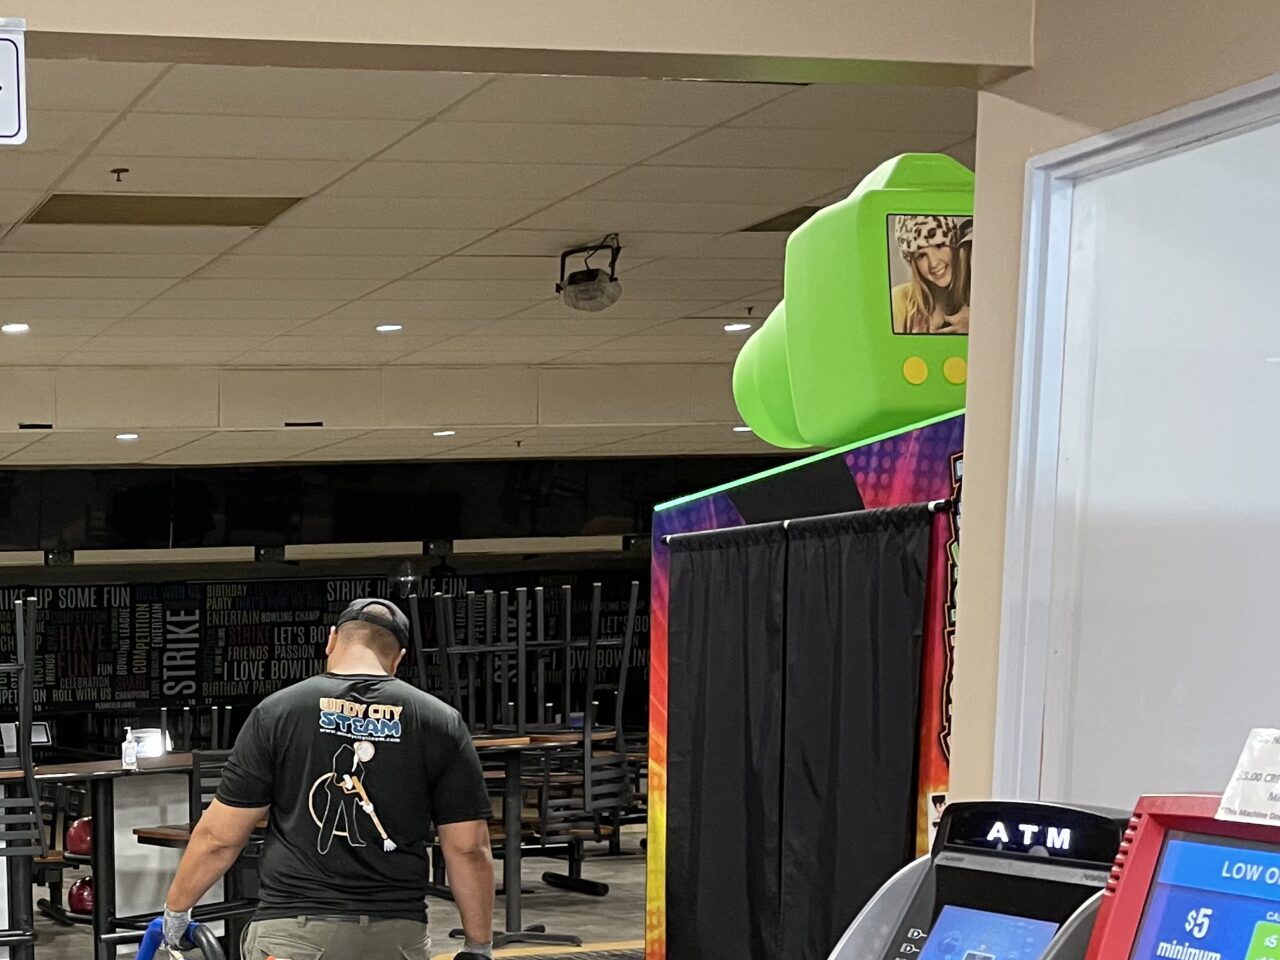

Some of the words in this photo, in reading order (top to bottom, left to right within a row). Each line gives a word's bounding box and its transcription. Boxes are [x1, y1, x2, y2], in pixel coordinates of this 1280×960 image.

[58, 587, 98, 609] SOME
[103, 586, 131, 608] FUN
[206, 584, 248, 598] BIRTHDAY
[326, 579, 372, 602] STRIKE
[206, 598, 233, 611] PARTY
[151, 602, 163, 648] ENTERTAIN
[206, 611, 260, 627] ENTERTAIN
[261, 611, 293, 623] BOWLING
[295, 610, 320, 622] CHAMP
[132, 602, 151, 674] COMPETITION
[274, 626, 305, 645] LET'S
[162, 609, 200, 696] STRIKE
[227, 645, 269, 661] FRIENDS
[274, 644, 315, 660] PASSION
[45, 653, 56, 686] FRIENDS
[97, 663, 113, 676] FUN
[223, 661, 228, 681] I
[233, 660, 265, 681] LOVE
[60, 677, 111, 689] CELEBRATION
[202, 681, 249, 697] BIRTHDAY
[252, 680, 283, 695] PARTY
[53, 689, 73, 703] ROLL
[76, 688, 97, 701] WITH
[100, 688, 113, 701] US
[368, 703, 403, 720] CITY
[319, 710, 402, 738] STEAM
[986, 821, 1071, 850] ATM
[1222, 860, 1263, 882] LOW
[1184, 907, 1213, 939] $5
[1264, 934, 1279, 949] $5
